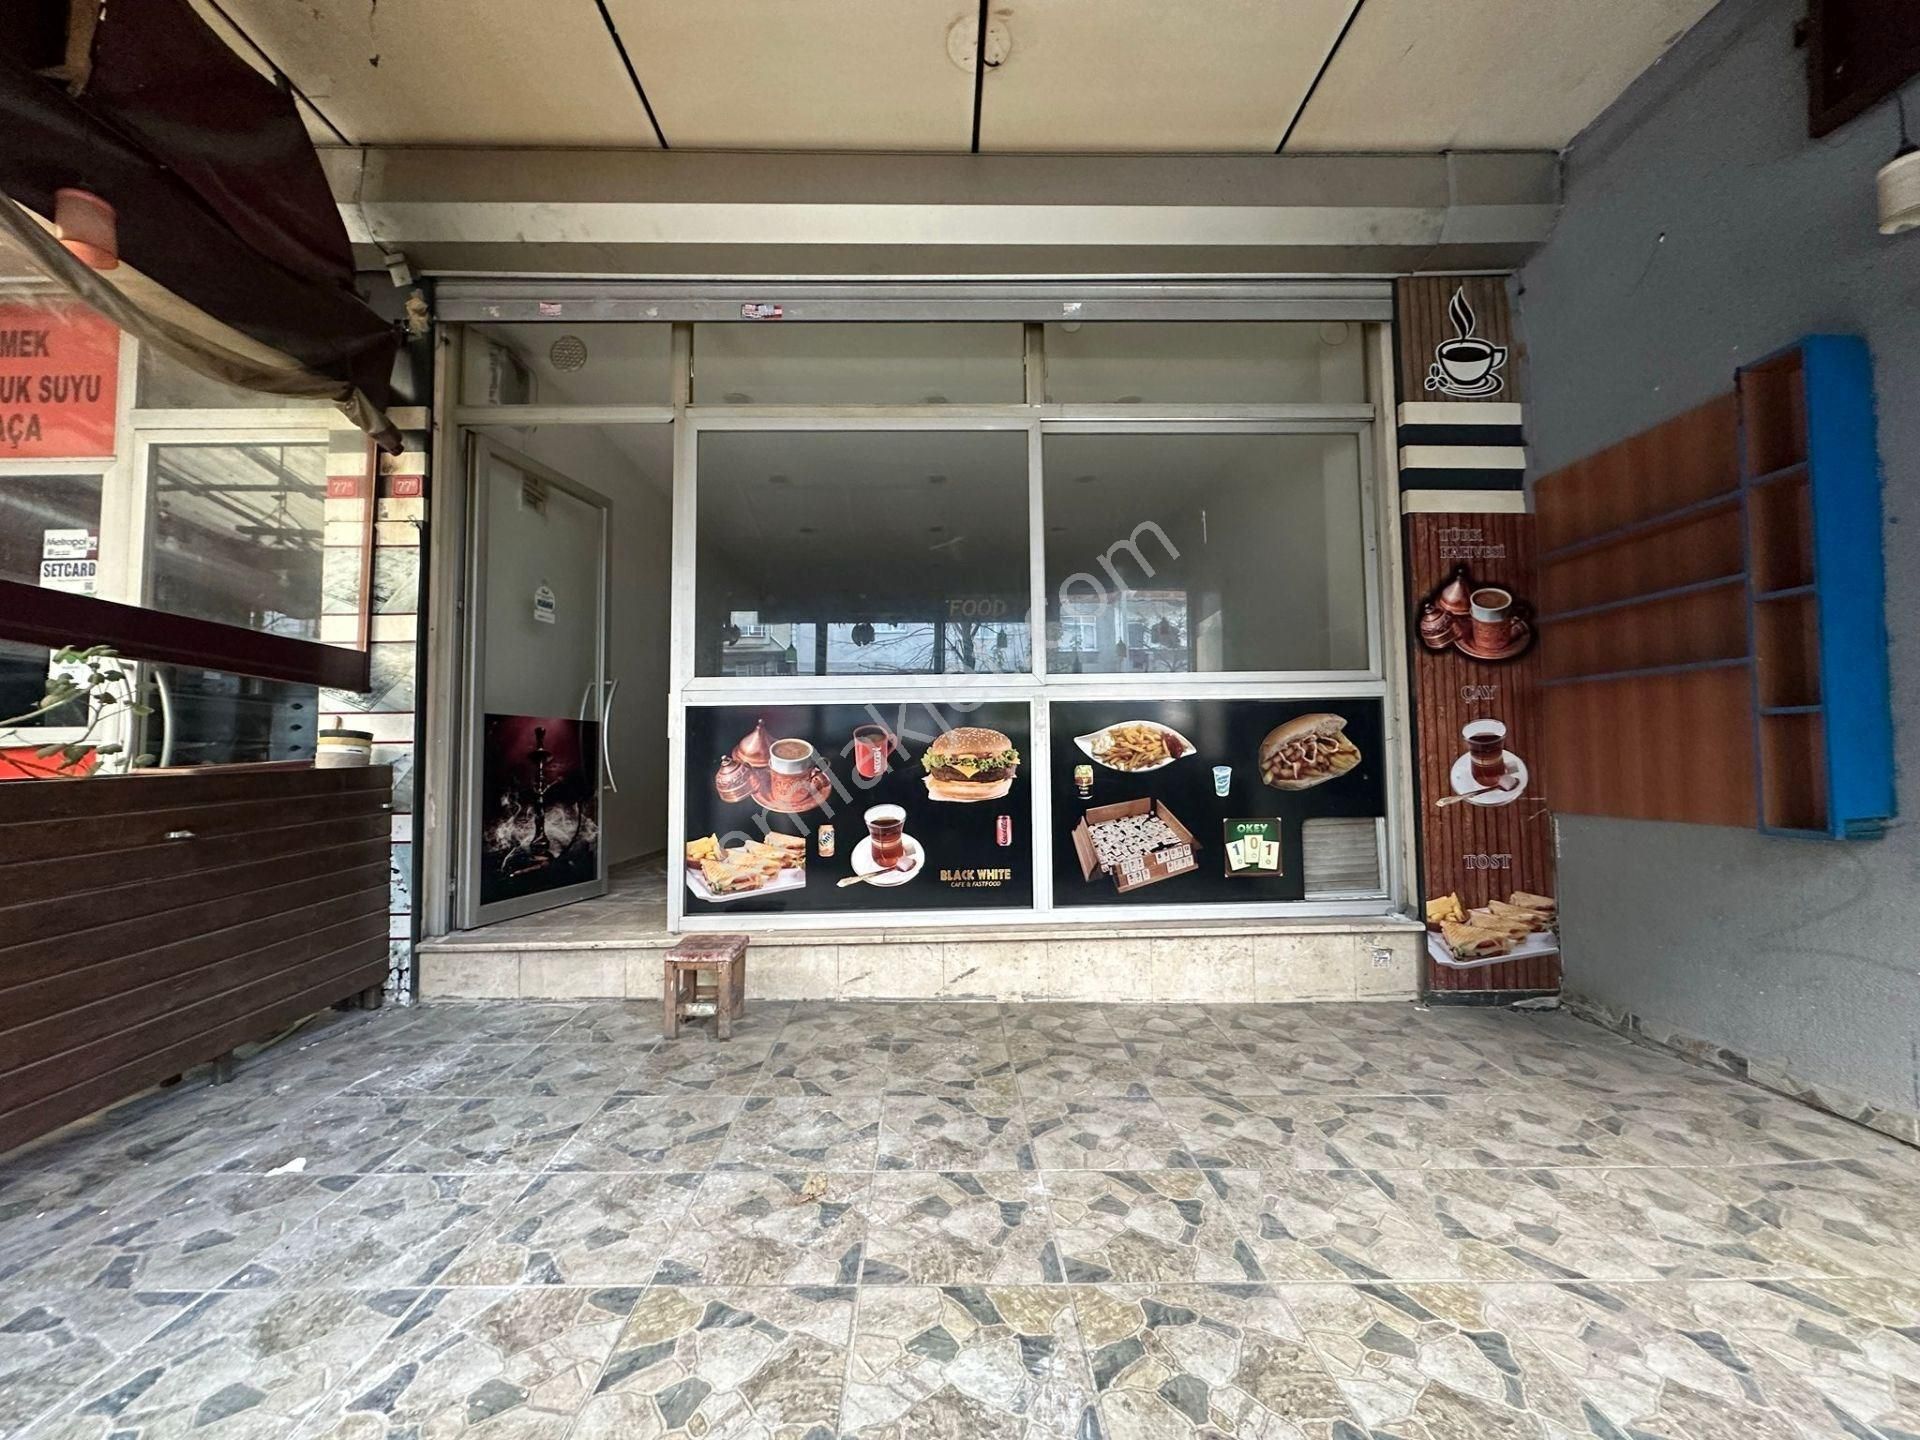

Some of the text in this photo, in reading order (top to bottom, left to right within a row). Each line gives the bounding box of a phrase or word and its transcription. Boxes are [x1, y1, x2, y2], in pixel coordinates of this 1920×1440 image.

[38, 374, 101, 404] SUYU
[43, 562, 96, 578] SETCARD
[950, 599, 1008, 617] FOOD
[1461, 685, 1498, 704] ÇAY
[1236, 823, 1269, 834] OKEY
[1462, 853, 1512, 870] TOST
[940, 868, 1011, 881] BLACK WHITE
